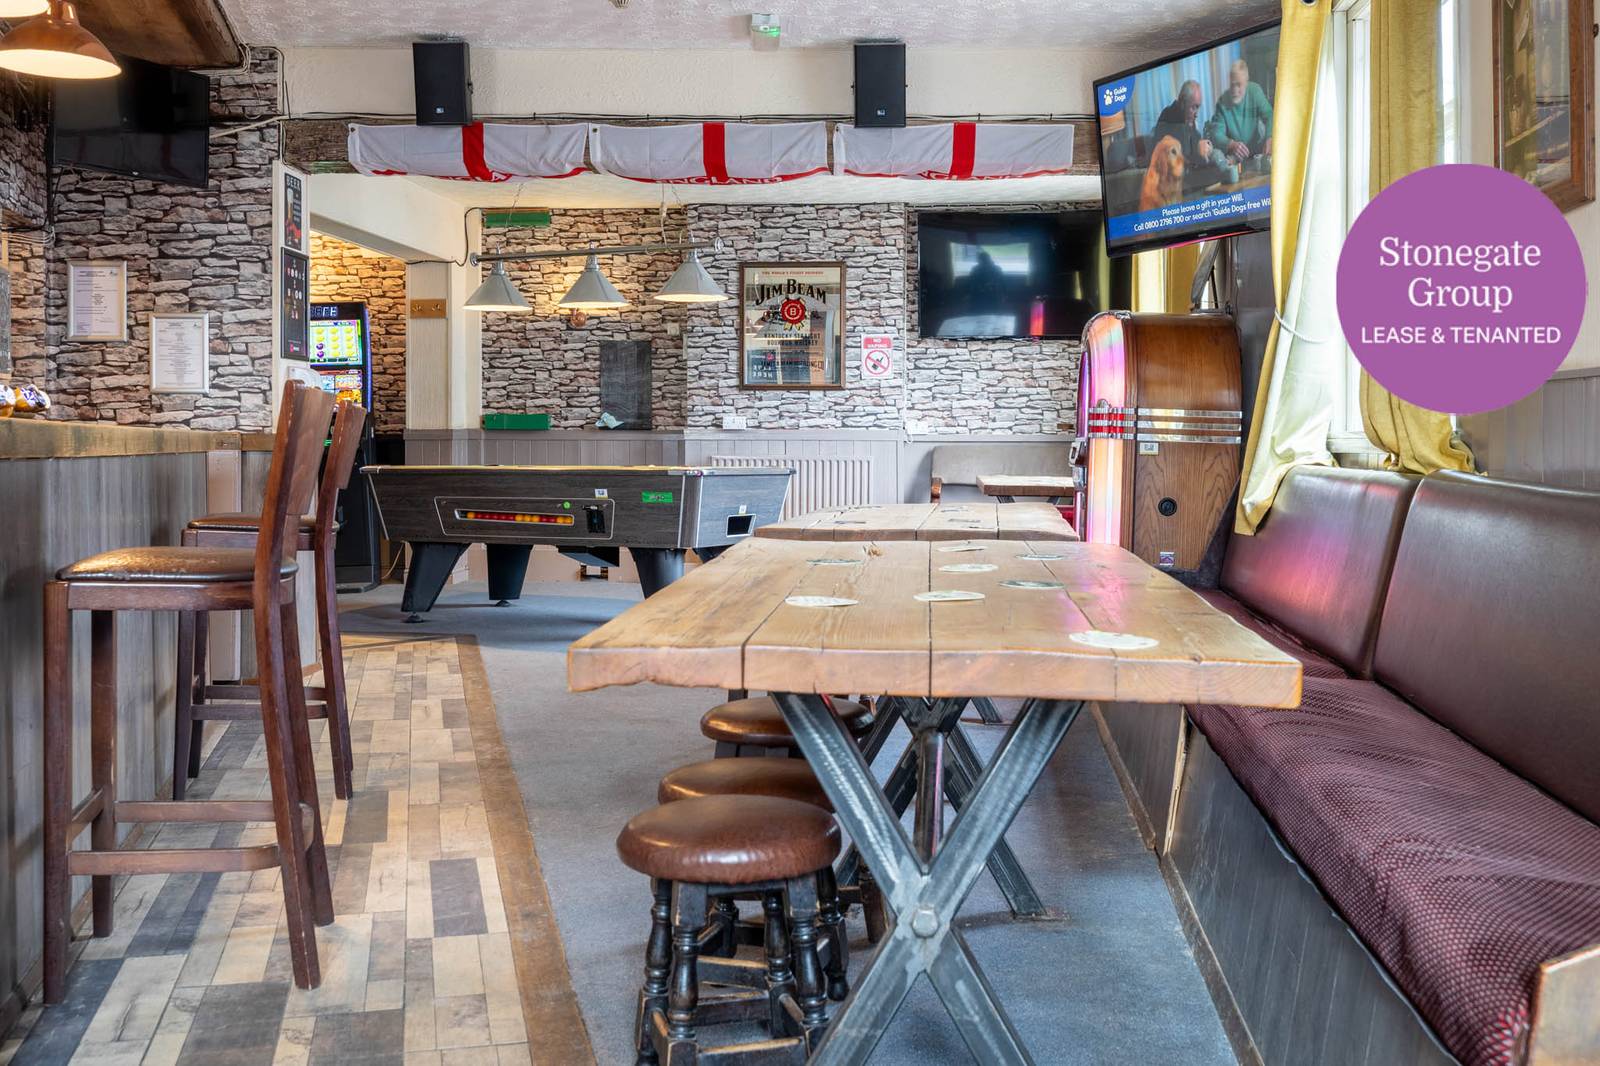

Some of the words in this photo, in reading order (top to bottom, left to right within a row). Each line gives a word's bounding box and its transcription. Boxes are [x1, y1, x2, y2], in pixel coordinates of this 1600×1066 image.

[1114, 86, 1128, 95] Guide
[1134, 223, 1144, 232] Call
[1144, 220, 1159, 229] 0800
[1173, 215, 1184, 224] 700
[1192, 210, 1212, 220] search
[1231, 204, 1246, 213] Dogs
[1162, 208, 1180, 216] Please
[1180, 204, 1196, 212] leave
[1200, 200, 1210, 210] gift
[1218, 197, 1230, 208] your
[756, 284, 783, 306] JIM
[787, 278, 826, 304] BEAM
